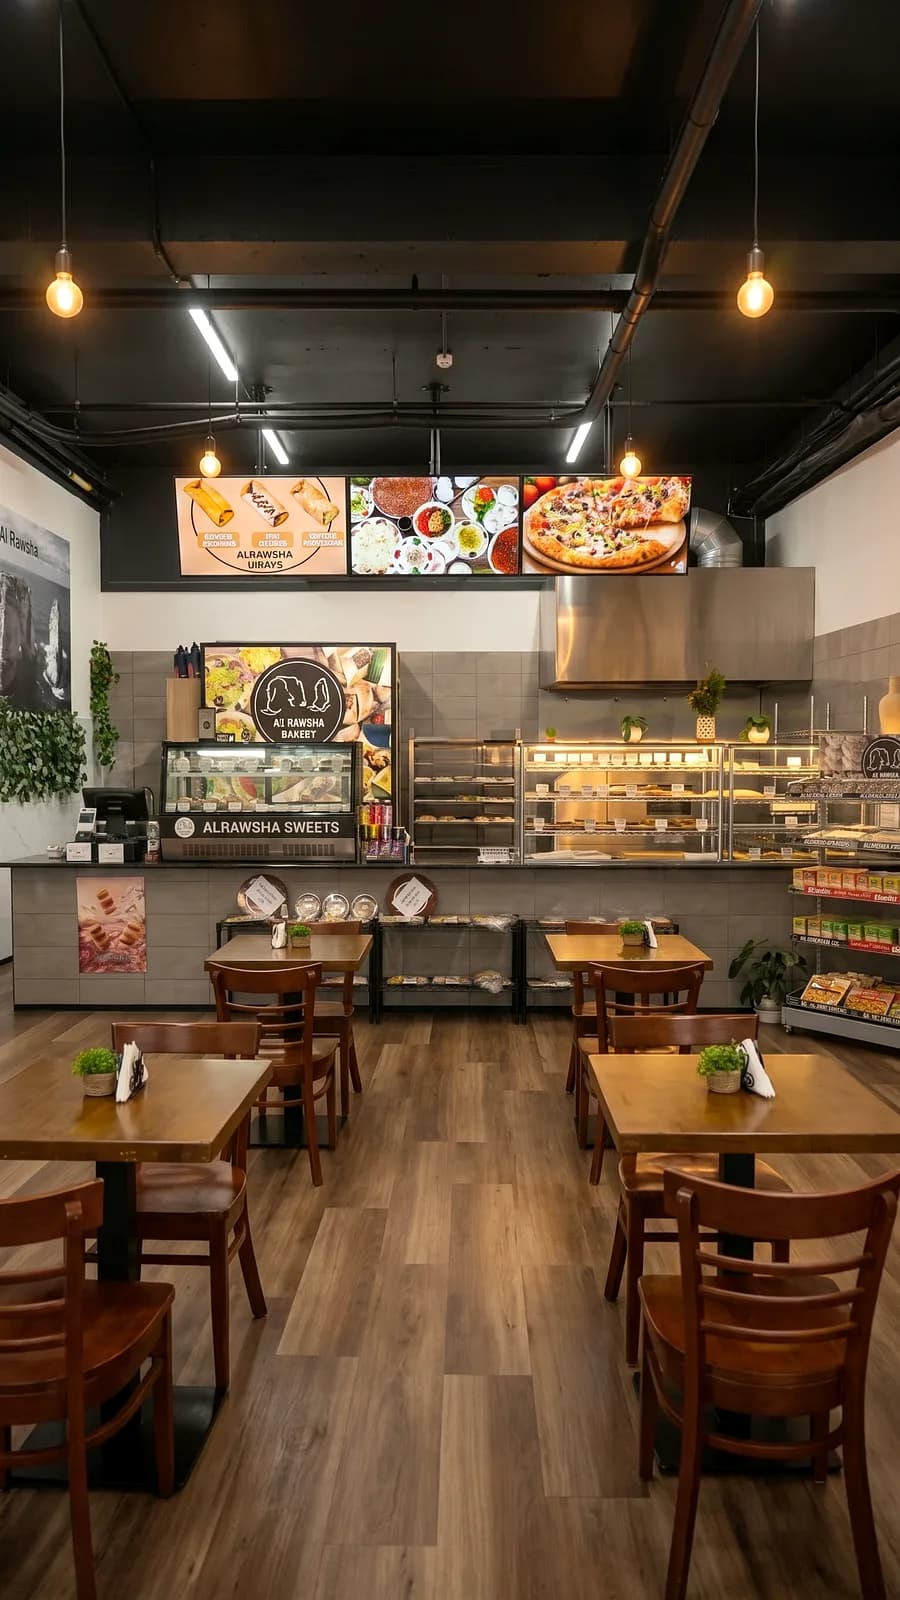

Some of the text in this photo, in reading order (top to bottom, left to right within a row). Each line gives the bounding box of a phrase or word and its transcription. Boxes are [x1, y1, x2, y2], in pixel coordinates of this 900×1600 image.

[9, 530, 39, 558] Rawsha
[236, 550, 293, 559] ALRAWSHA
[287, 718, 325, 727] RAWSHA
[203, 821, 340, 834] ALRAWSHA SWEETS
